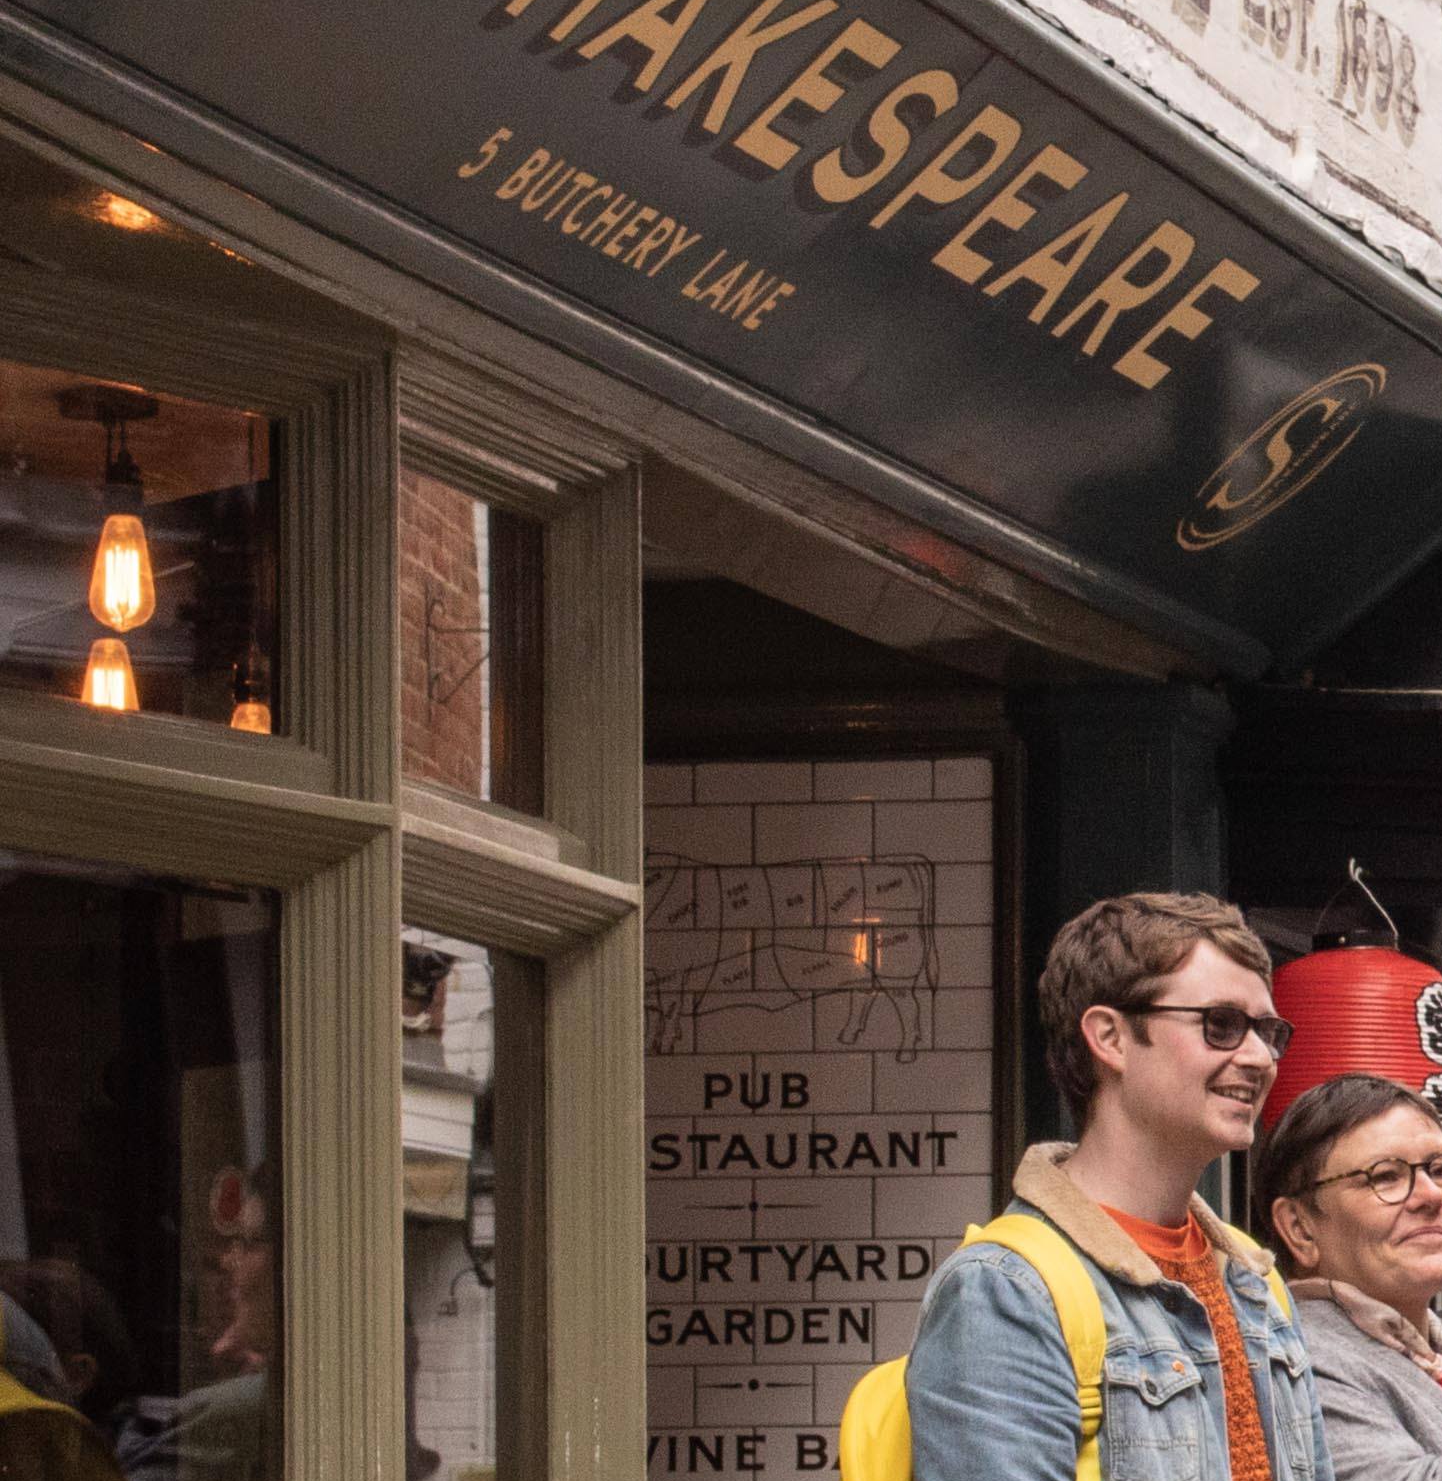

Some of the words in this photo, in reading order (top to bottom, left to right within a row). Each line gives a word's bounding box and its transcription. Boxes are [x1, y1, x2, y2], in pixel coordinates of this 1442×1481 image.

[457, 126, 513, 178] 5
[495, 147, 702, 277] BUTCHERY
[681, 249, 796, 331] LANE
[703, 1073, 811, 1110] PUB
[649, 1131, 958, 1172] STAURANT
[646, 1244, 930, 1283] URTYARD
[646, 1307, 871, 1346] GARDEN
